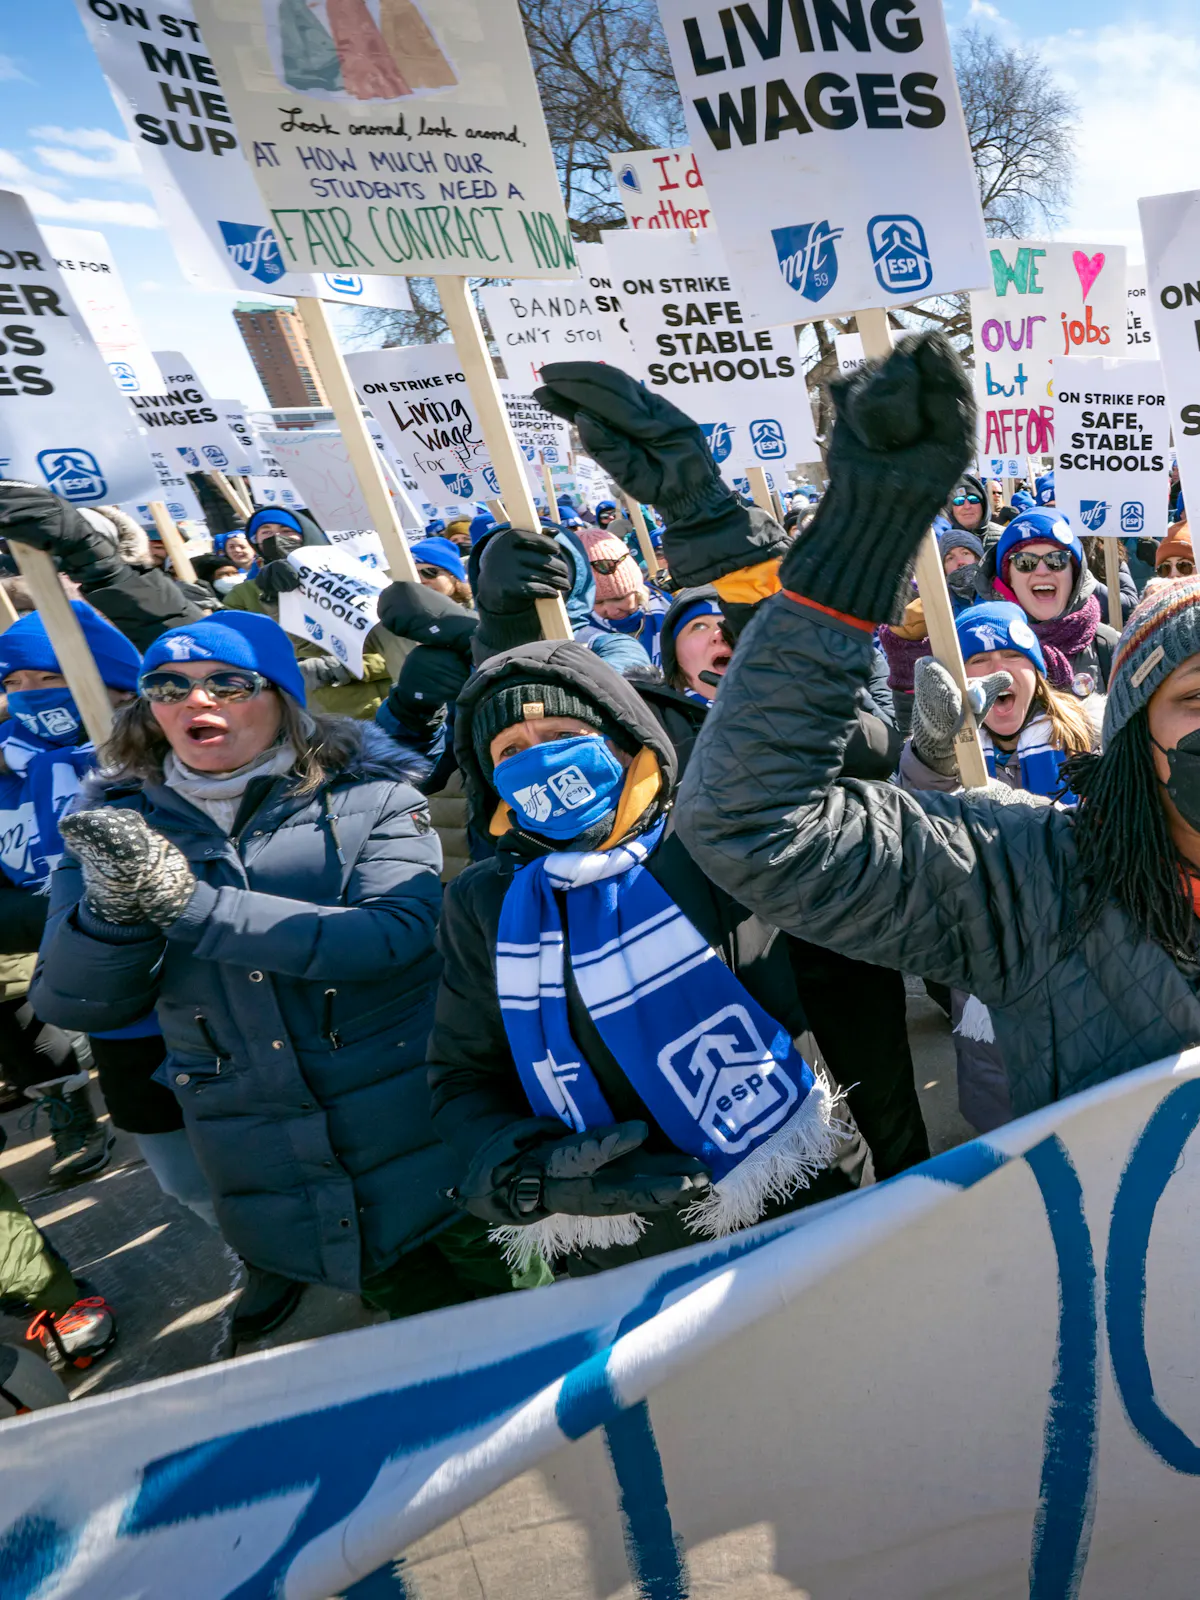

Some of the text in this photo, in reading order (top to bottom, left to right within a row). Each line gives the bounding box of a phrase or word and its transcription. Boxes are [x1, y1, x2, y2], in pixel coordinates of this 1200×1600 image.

[88, 0, 151, 31] ON
[683, 0, 924, 77] LIVING
[278, 107, 340, 134] Look
[417, 116, 458, 138] look
[693, 72, 947, 151] WAGES
[253, 142, 493, 175] AT HOW MUCH OUR
[653, 153, 704, 192] I'd
[310, 177, 526, 201] STUDENTS NEED A
[631, 199, 711, 230] rather
[270, 205, 578, 271] FAIR CONTRACT NOW
[0, 250, 47, 272] OR
[80, 260, 112, 274] FOR
[780, 220, 845, 296] mft
[888, 257, 918, 276] ESP
[589, 277, 613, 289] ON
[814, 273, 829, 287] 59
[989, 247, 1047, 298] WE
[622, 276, 731, 295] ON STRIKE
[1127, 288, 1147, 298] FOR
[510, 296, 593, 319] BANDA
[662, 300, 744, 327] SAFE
[506, 326, 552, 347] CAN'T
[981, 305, 1111, 355] our jobs
[656, 330, 774, 357] STABLE
[648, 355, 796, 386] SCHOOLS
[842, 360, 857, 369] ON
[168, 373, 195, 385] FOR
[363, 372, 466, 394] ON STRIKE FO
[985, 362, 1028, 398] but
[129, 388, 204, 409] LIVING
[505, 401, 545, 412] MENTA
[1059, 392, 1166, 406] ON STRIKE FOR
[136, 407, 218, 428] WAGES
[388, 397, 472, 431] Living
[508, 411, 554, 421] HEALTH
[510, 420, 564, 431] UPPORTS
[1081, 411, 1144, 433] SAFE,
[984, 405, 1055, 456] AFFOR
[1071, 432, 1154, 451] STABLE
[413, 451, 446, 474] for
[1059, 453, 1165, 472] SCHOOLS
[64, 477, 93, 491] ESP
[1080, 500, 1113, 528] mft
[298, 566, 373, 613] STABLE
[299, 584, 369, 631] CHOOLS
[566, 786, 584, 798] esp
[716, 1073, 765, 1114] esp
